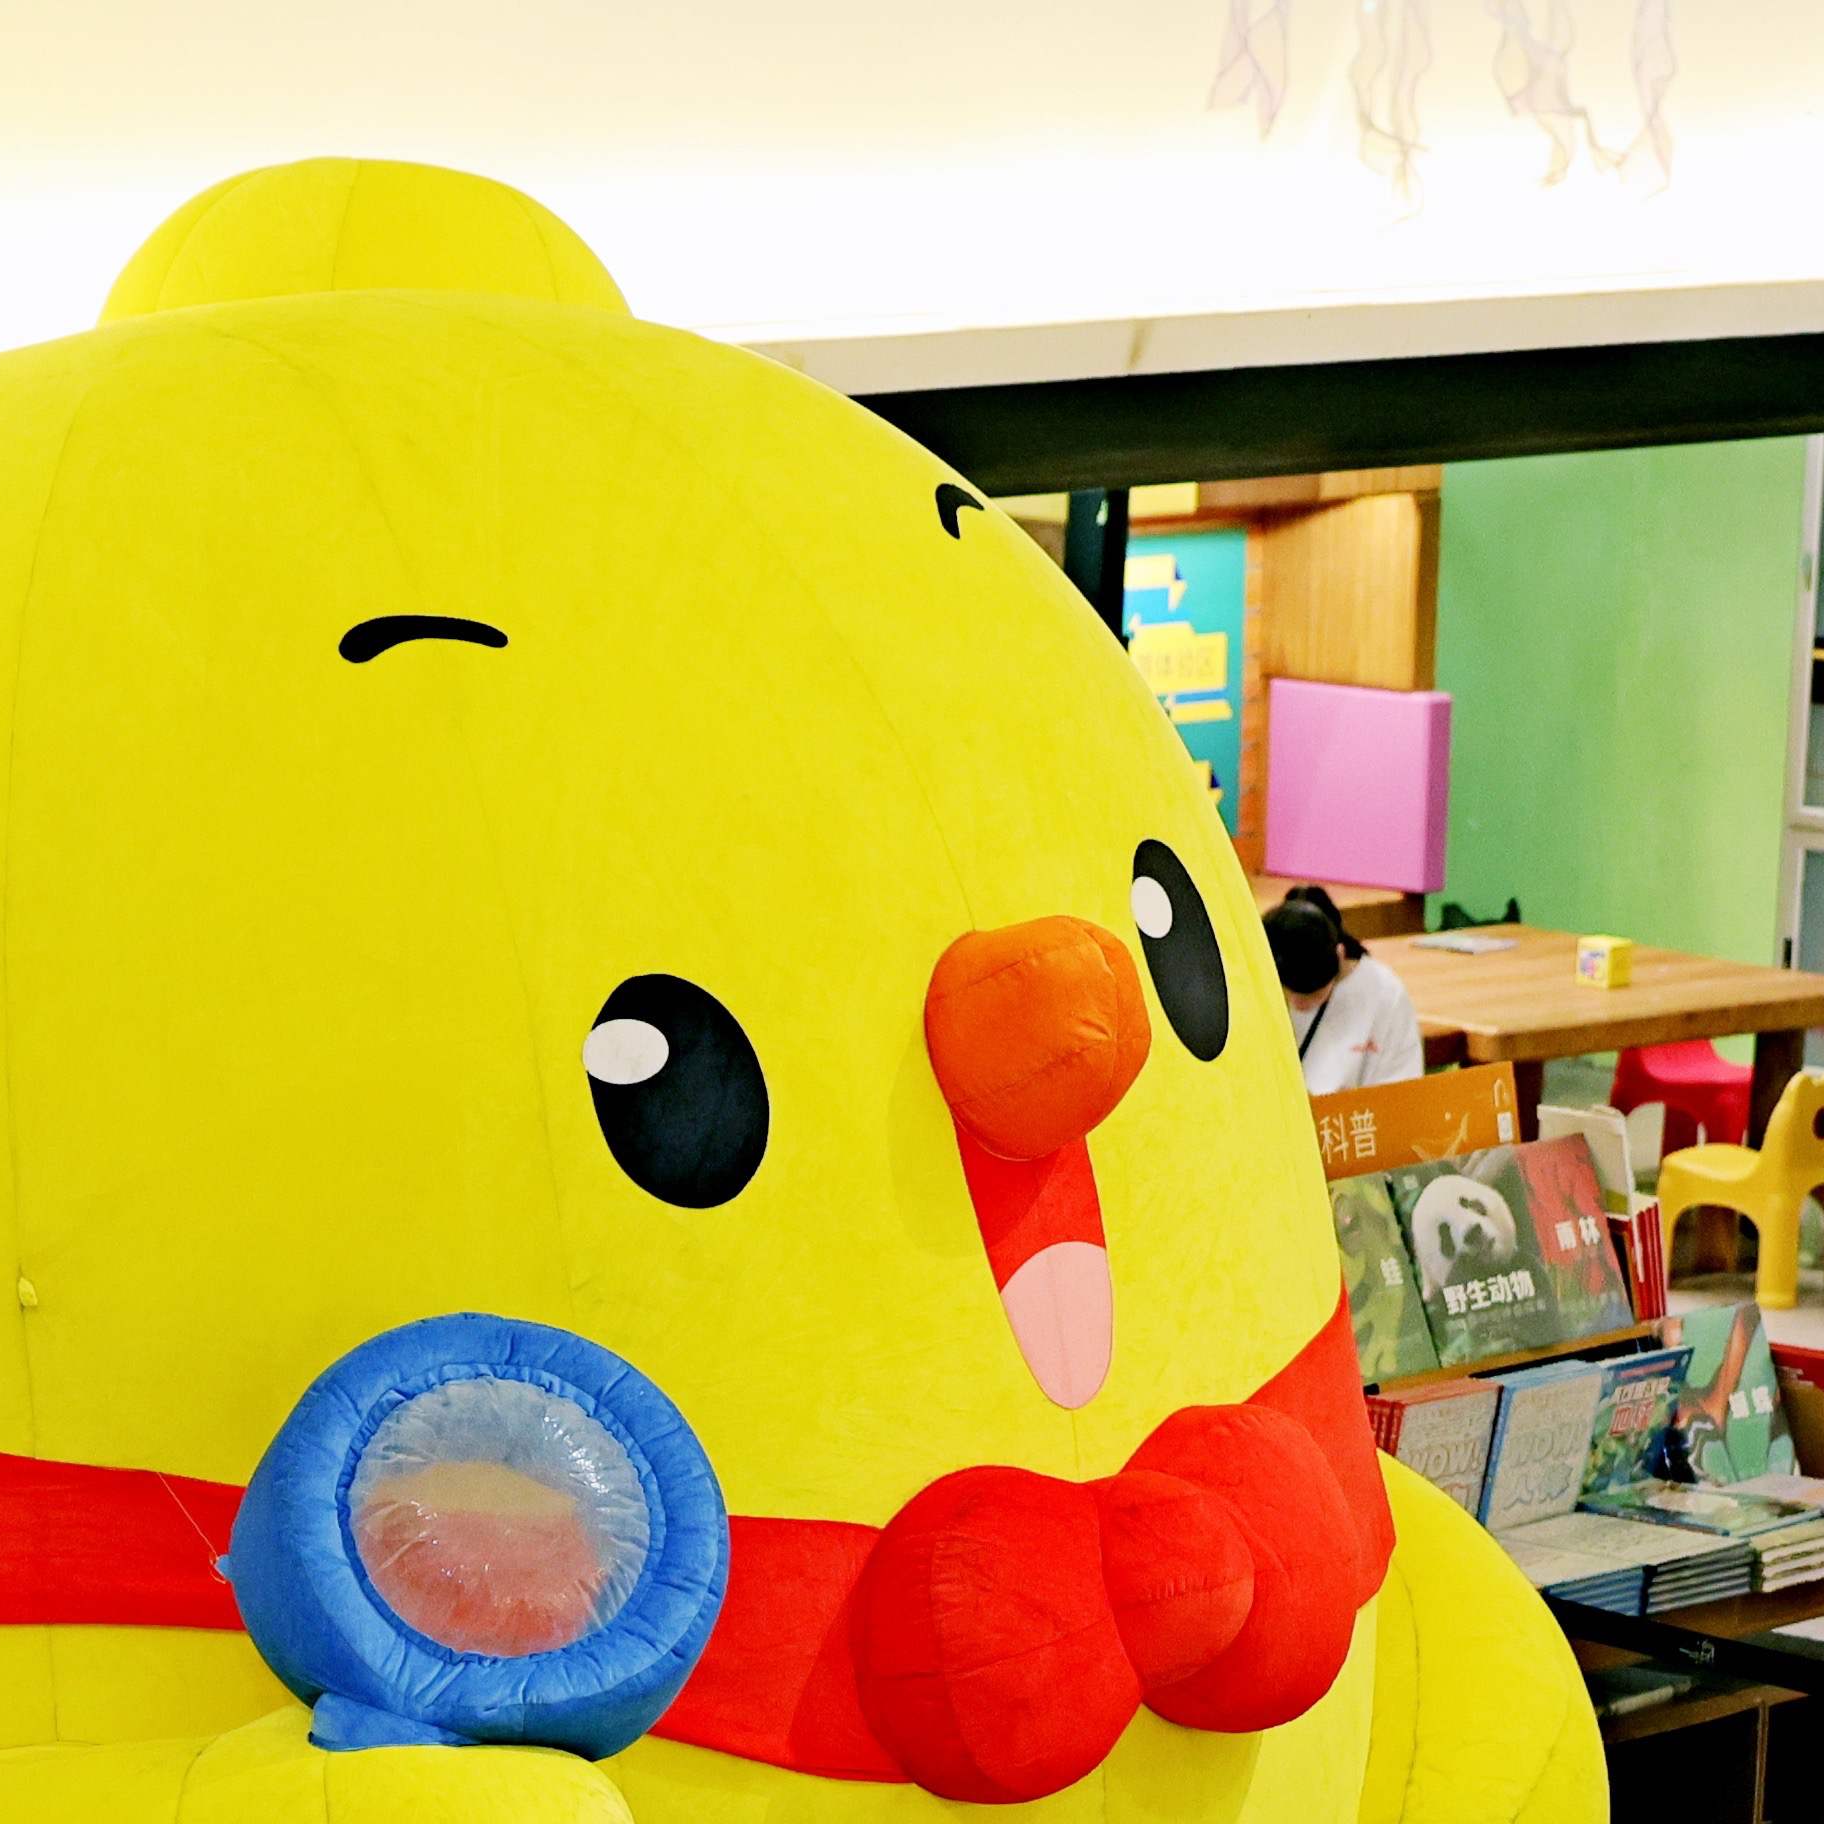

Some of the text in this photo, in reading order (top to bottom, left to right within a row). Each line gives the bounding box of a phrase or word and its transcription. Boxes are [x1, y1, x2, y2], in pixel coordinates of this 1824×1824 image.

[1320, 1108, 1378, 1164] 科普
[1442, 1269, 1536, 1316] 野生动物
